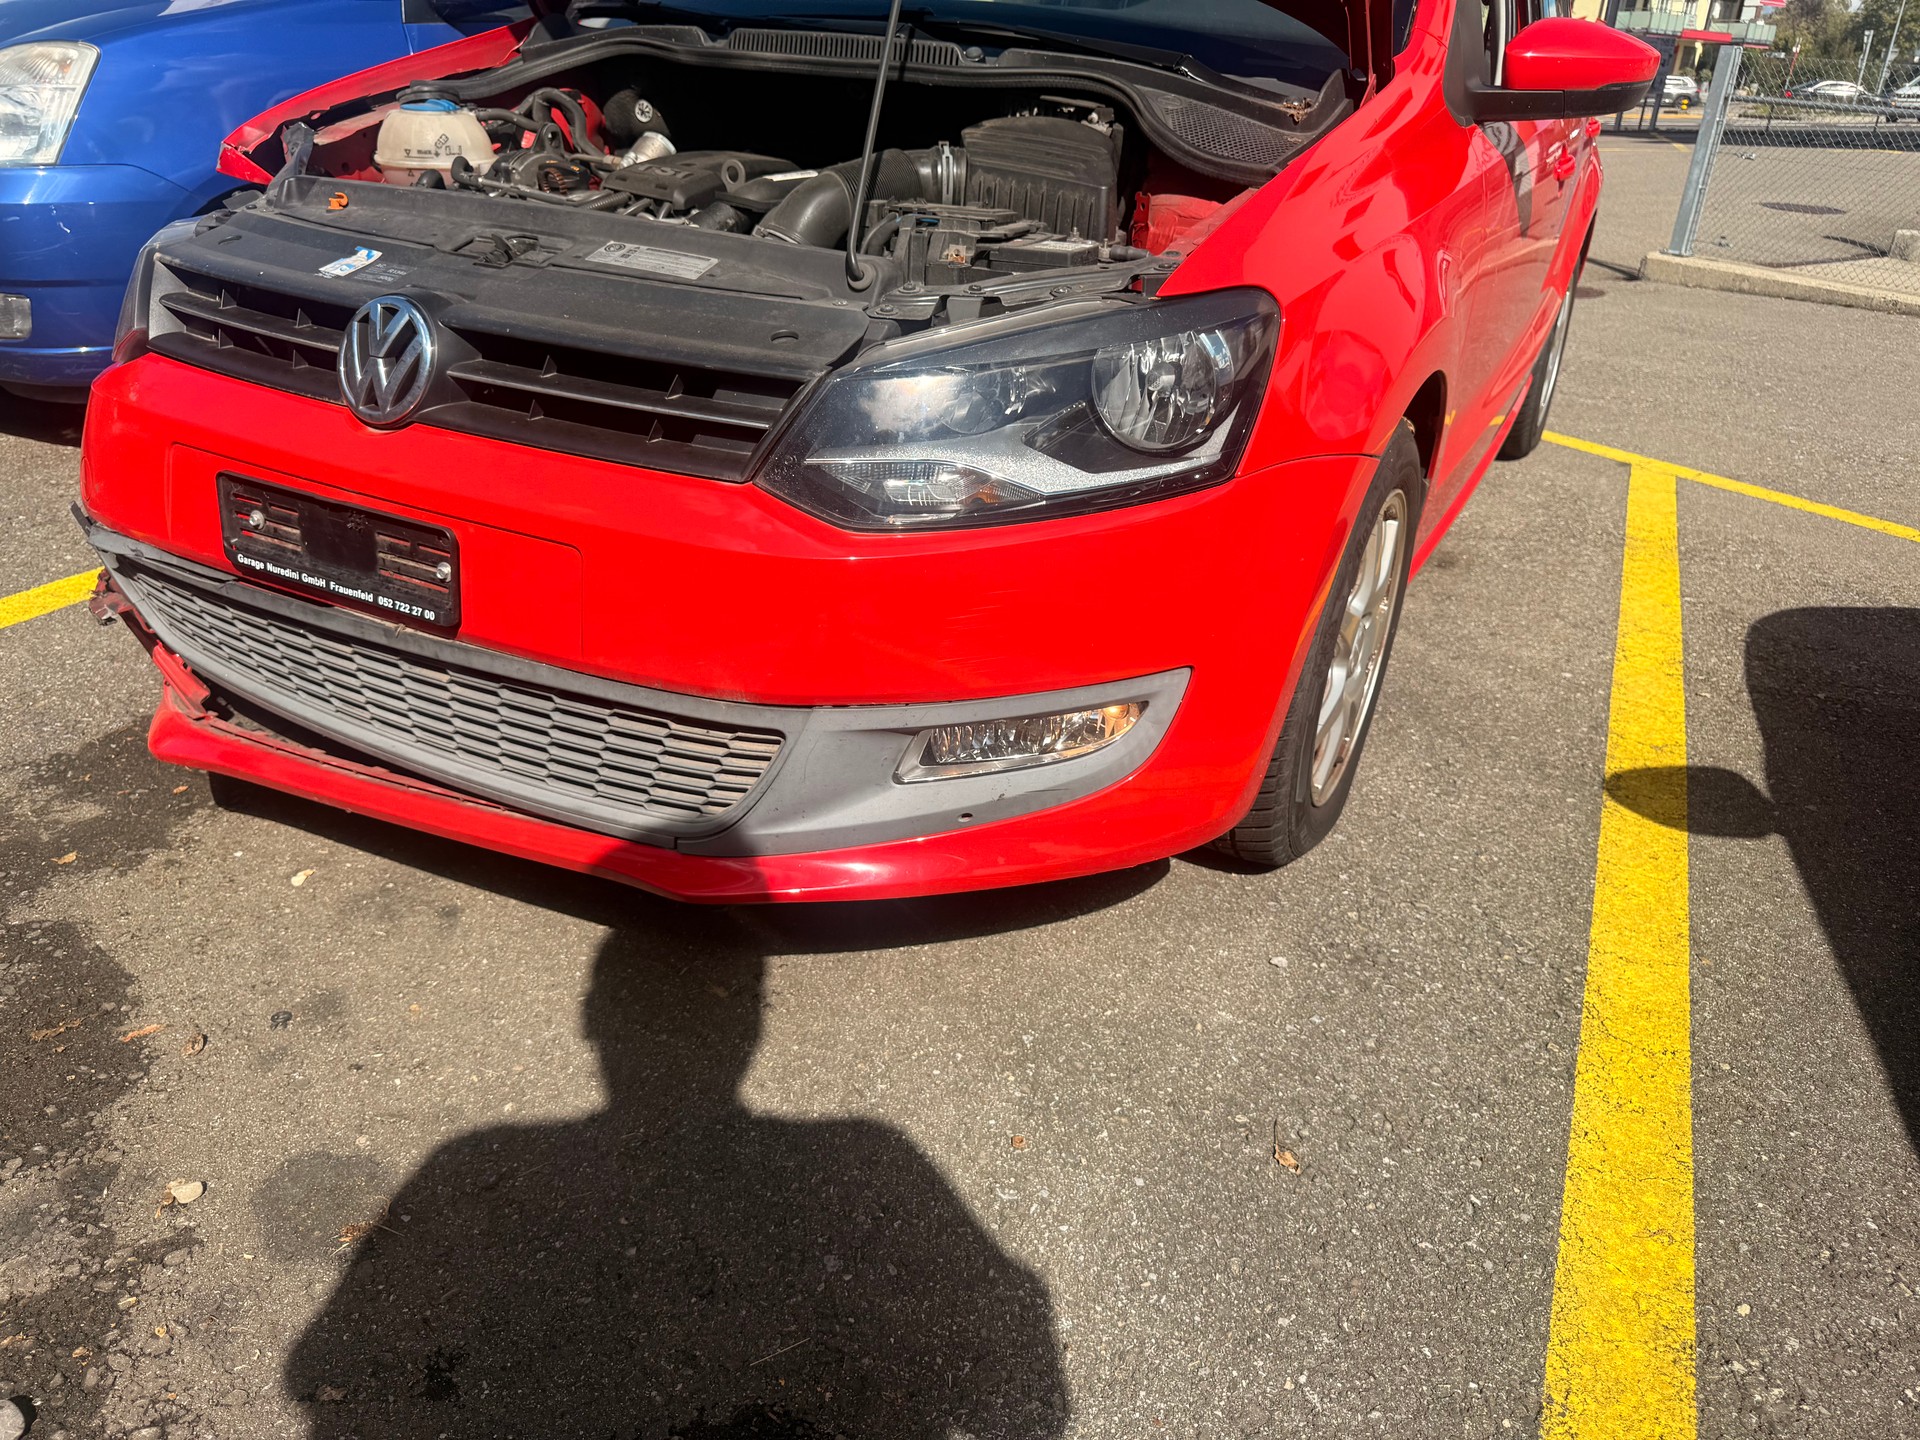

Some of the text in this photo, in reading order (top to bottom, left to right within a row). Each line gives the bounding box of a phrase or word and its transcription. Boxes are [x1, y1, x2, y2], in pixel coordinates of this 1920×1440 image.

[237, 554, 435, 621] Garage Nuredini GmbH Frauenfeld 052 722 27 00
